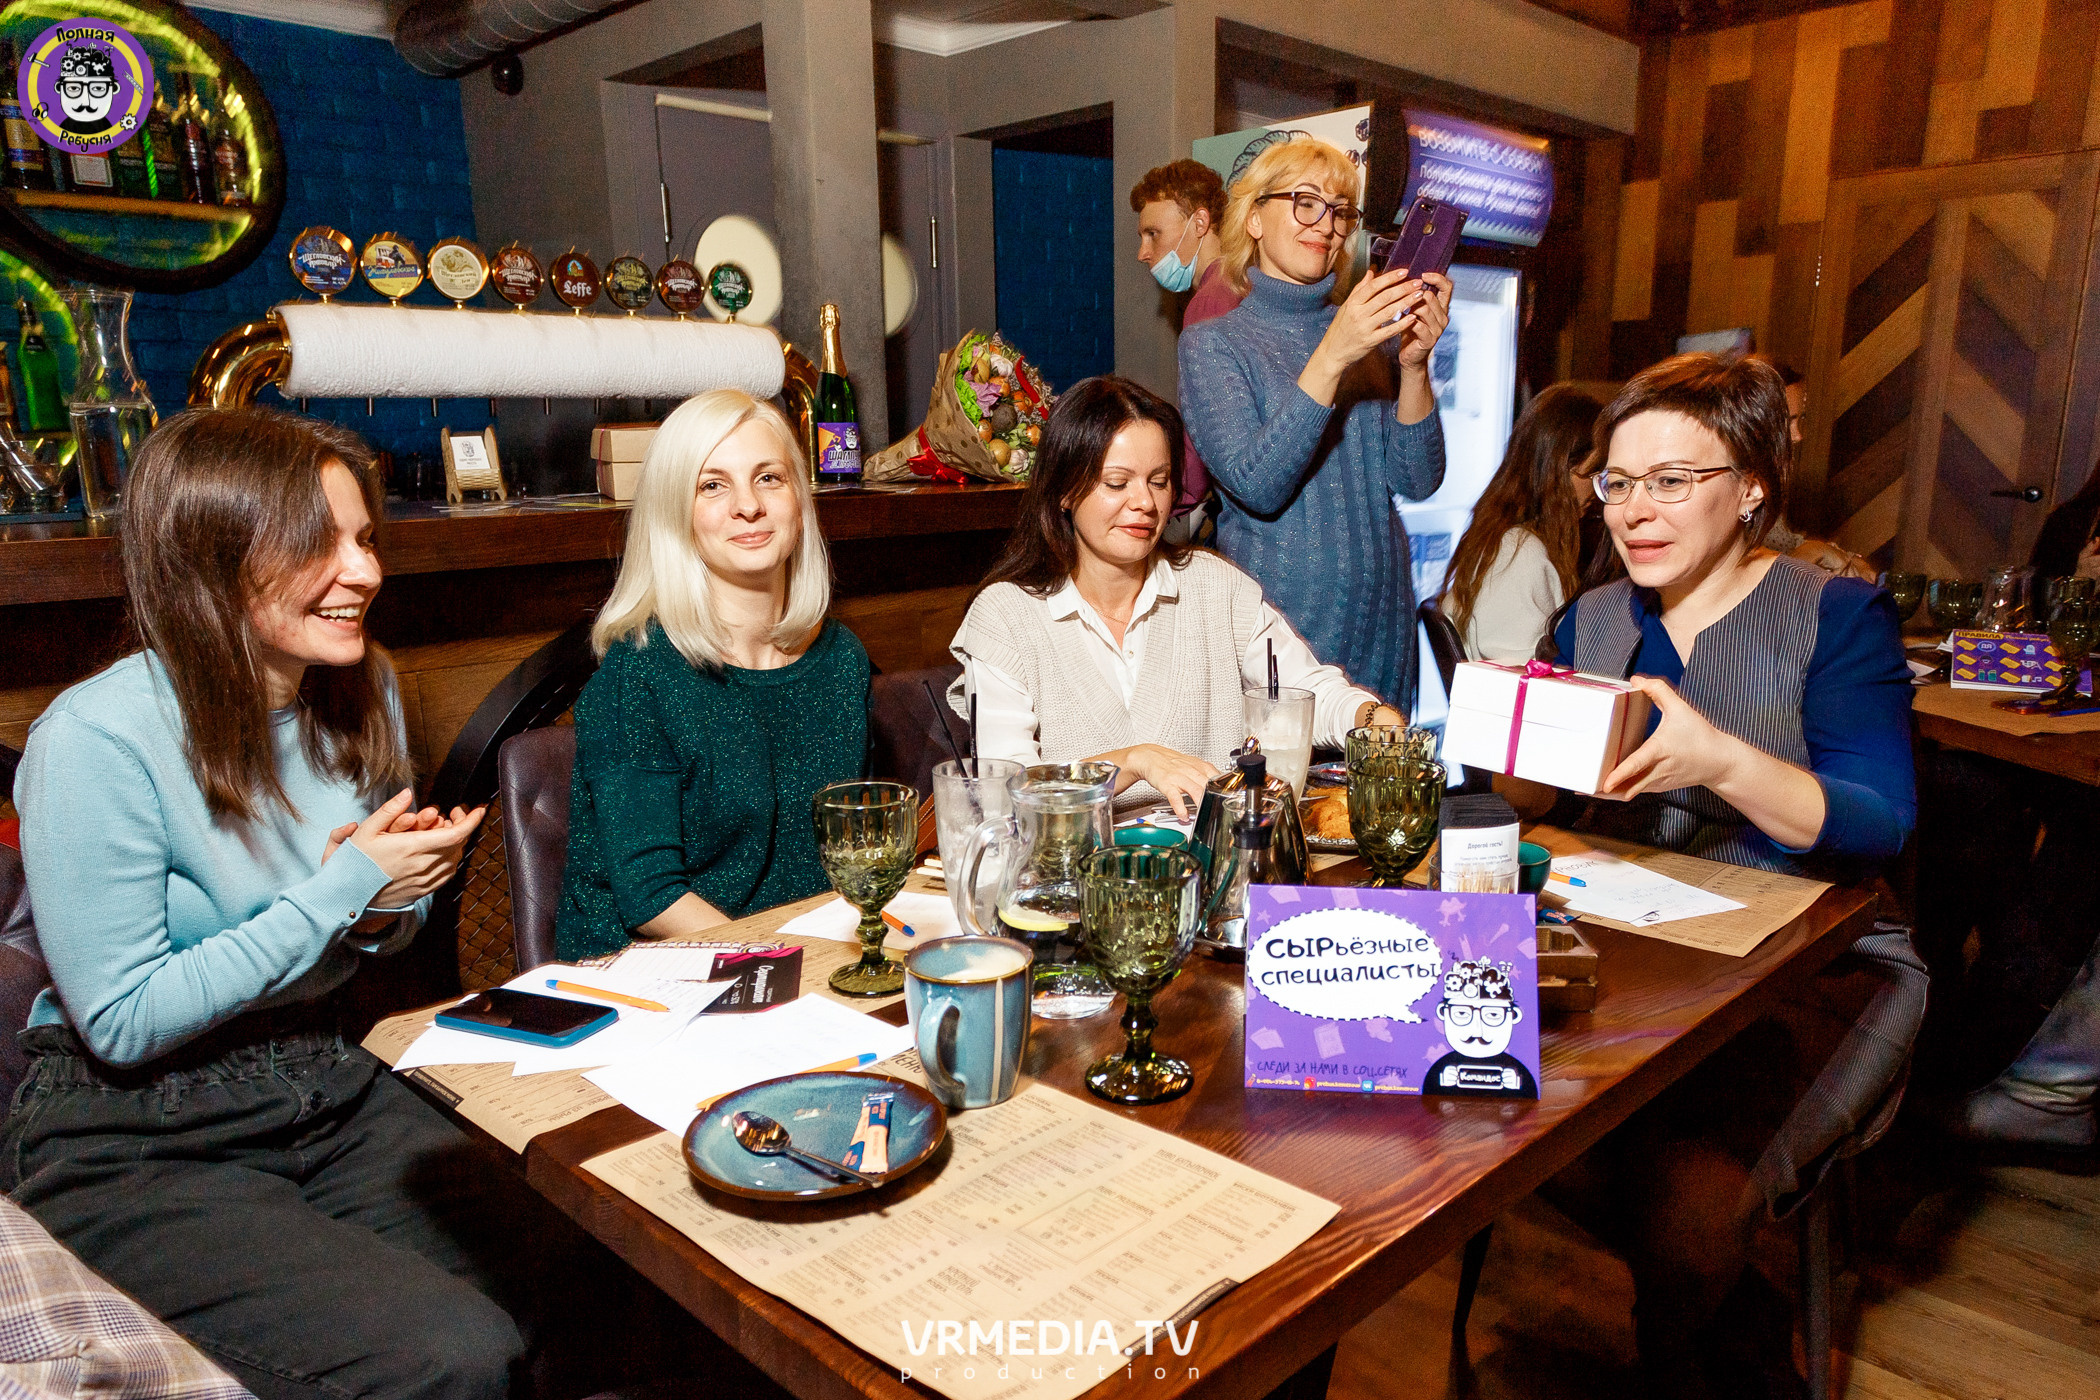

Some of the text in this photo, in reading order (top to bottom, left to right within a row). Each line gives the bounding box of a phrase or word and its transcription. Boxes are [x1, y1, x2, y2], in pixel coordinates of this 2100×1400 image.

[563, 280, 592, 297] Leffe
[1958, 631, 2001, 640] ПРАВИЛА
[1265, 936, 1429, 959] СЫРьёзные
[1261, 962, 1440, 985] специалисты
[1257, 1061, 1290, 1074] СЛЕДИ
[1294, 1062, 1306, 1073] ЗА
[1310, 1063, 1338, 1075] НАМИ
[1342, 1064, 1349, 1074] В
